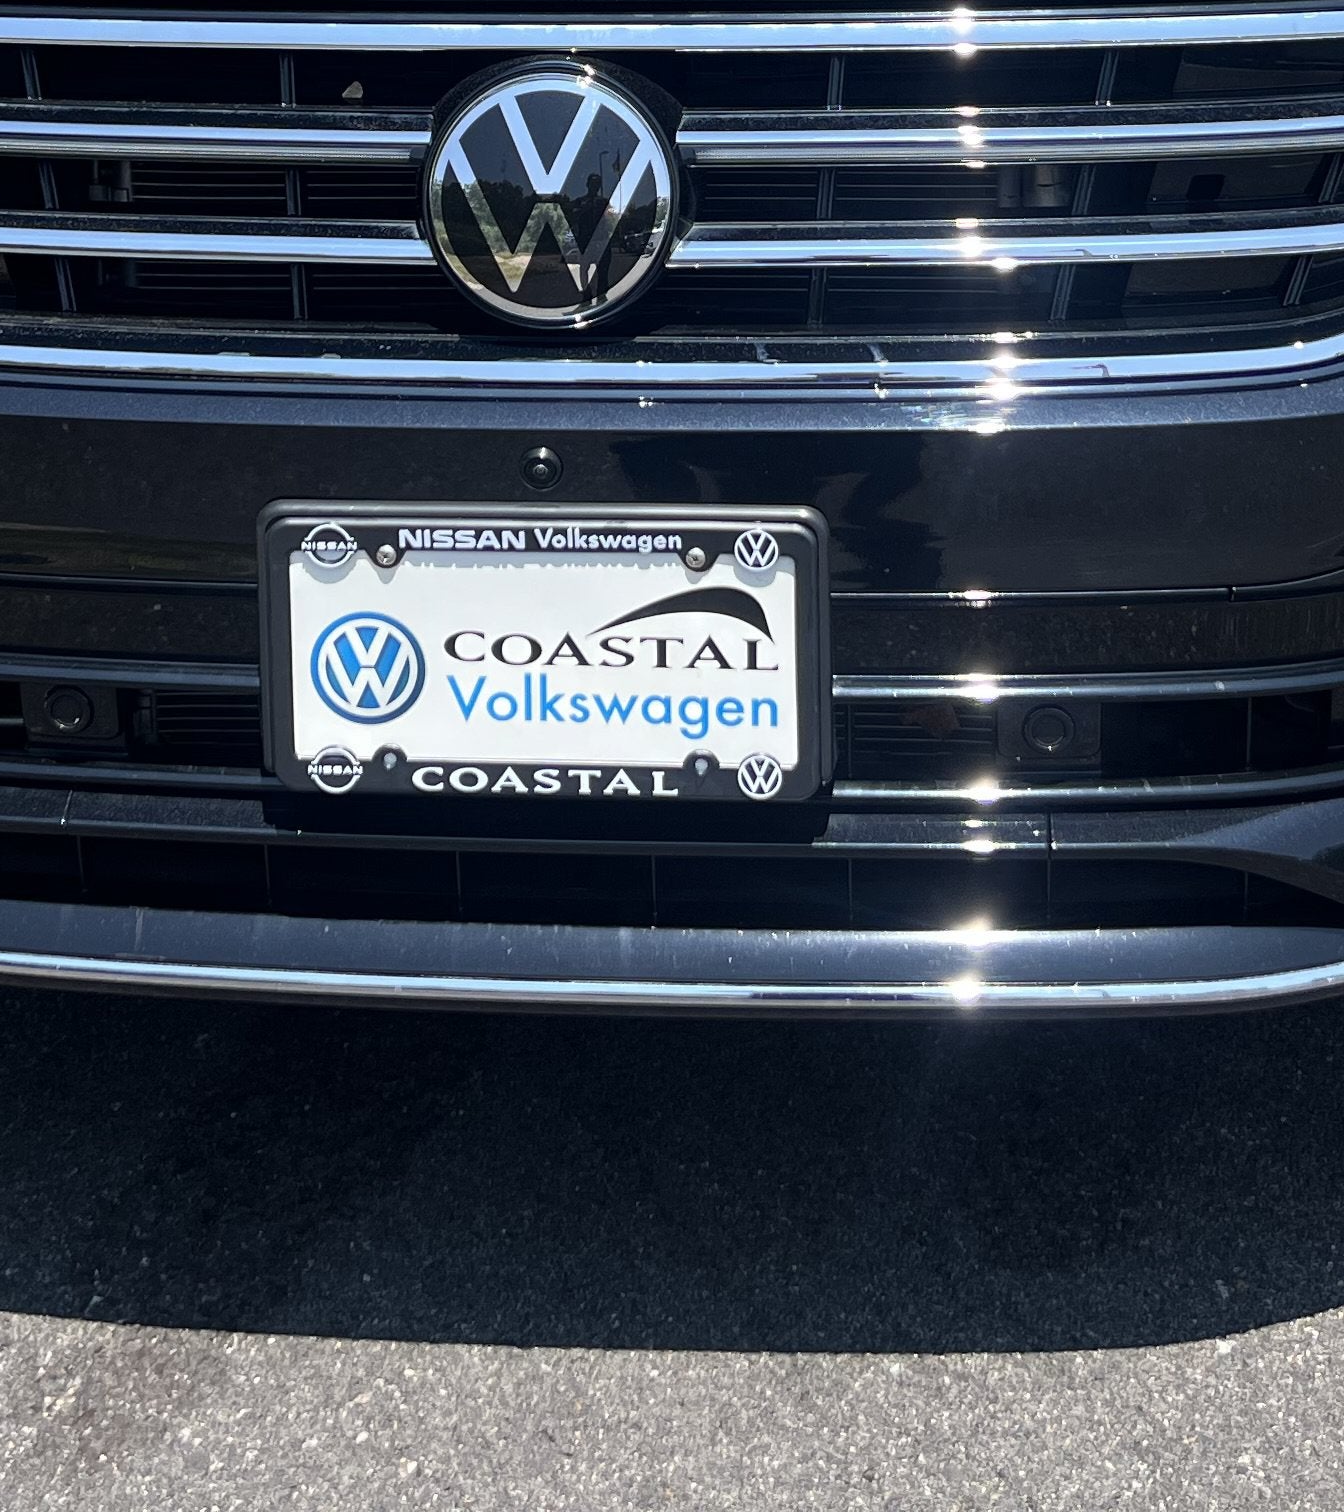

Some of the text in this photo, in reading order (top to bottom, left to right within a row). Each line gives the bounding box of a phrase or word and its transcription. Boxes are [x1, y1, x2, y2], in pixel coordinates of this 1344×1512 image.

[301, 541, 357, 550] NISSAN
[398, 527, 683, 554] NISSAN Volkswagen
[444, 631, 780, 671] COASTAL
[446, 673, 779, 739] Volkswagen
[308, 765, 363, 775] NISSAN
[412, 766, 678, 796] COASTAL
